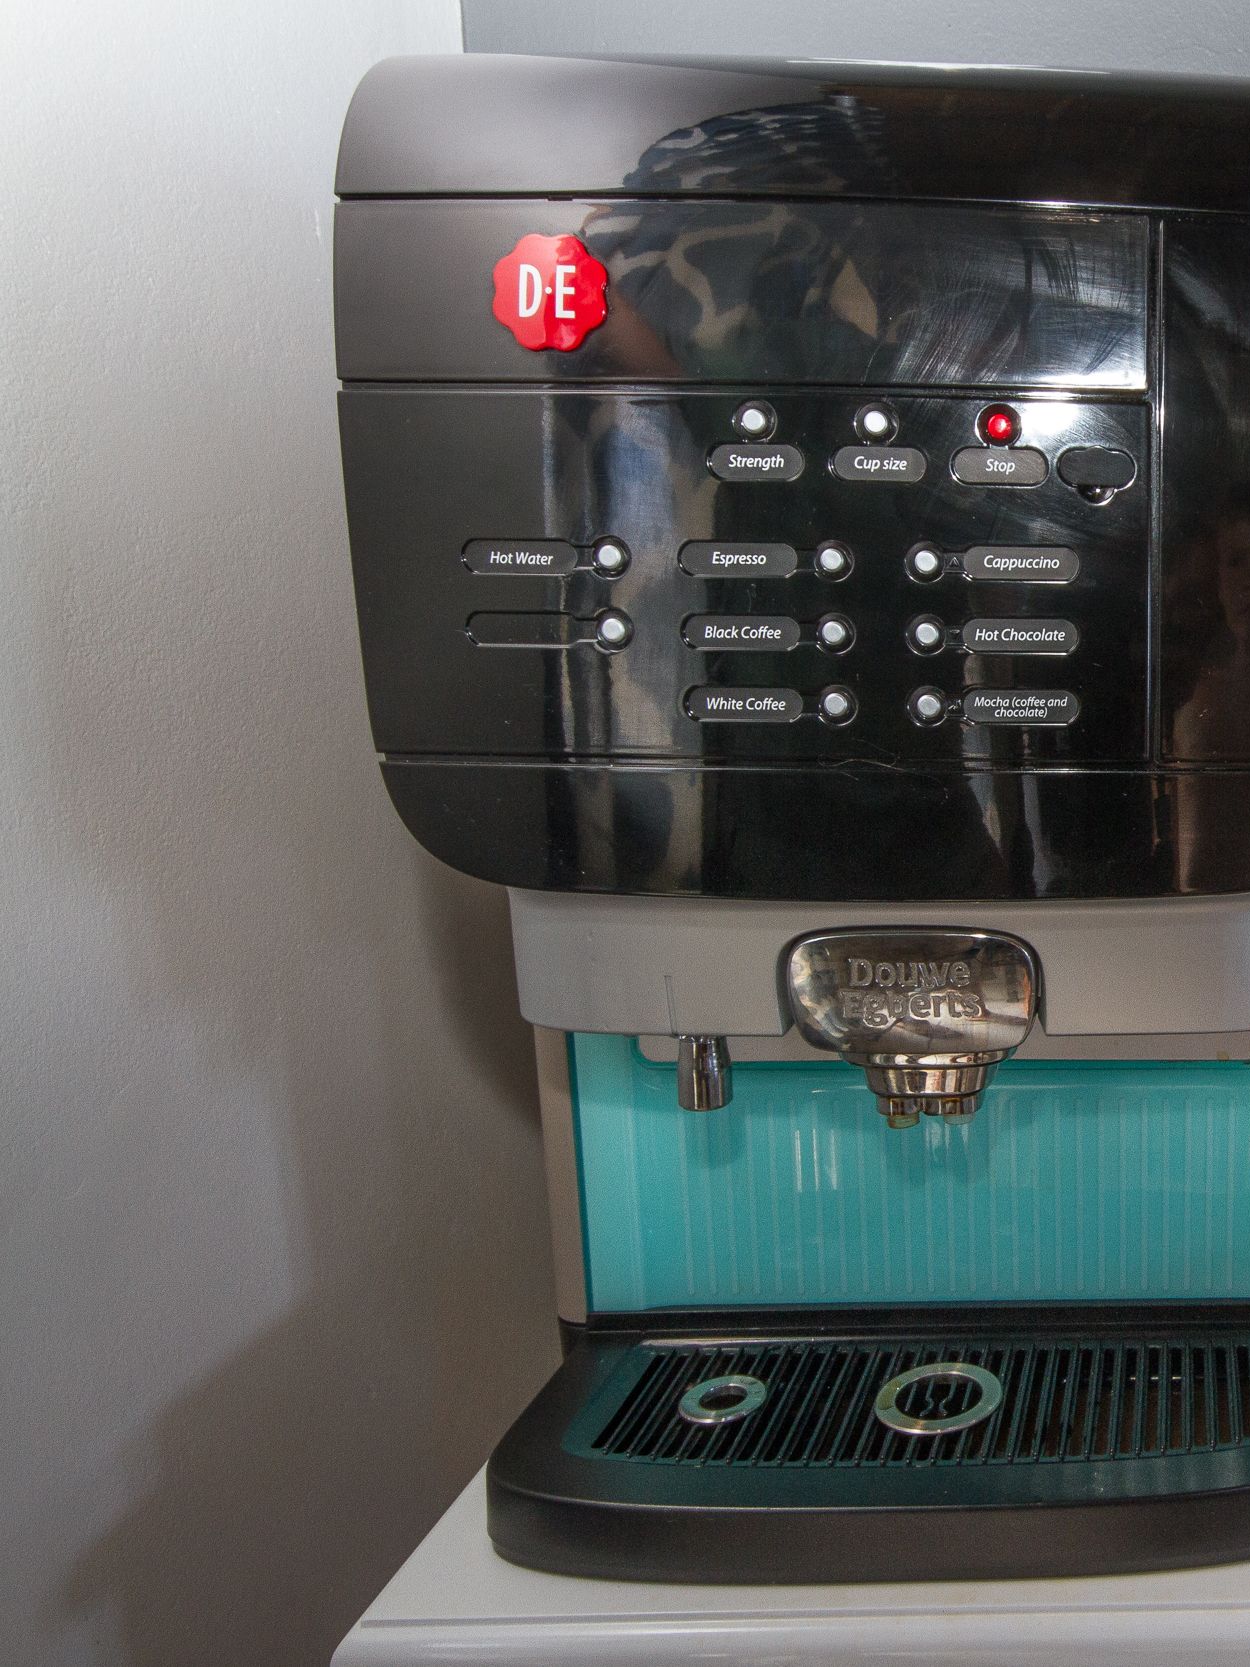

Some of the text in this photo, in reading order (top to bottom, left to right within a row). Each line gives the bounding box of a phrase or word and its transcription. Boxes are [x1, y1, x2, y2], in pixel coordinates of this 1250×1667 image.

[728, 454, 785, 471] Strength
[853, 455, 908, 473] Cup size
[985, 457, 1016, 475] Stop
[489, 551, 554, 567] Hot Water
[711, 551, 767, 568] Espresso
[983, 554, 1060, 571] Cappuccino
[704, 625, 782, 640] Black Coffee
[974, 627, 1066, 642] Hot Chocolate
[706, 696, 786, 712] White Coffee
[974, 696, 1068, 708] Mocha (coffee and
[994, 706, 1048, 719] chocolate)
[847, 957, 971, 987] Douwe
[841, 989, 981, 1026] Egberts
